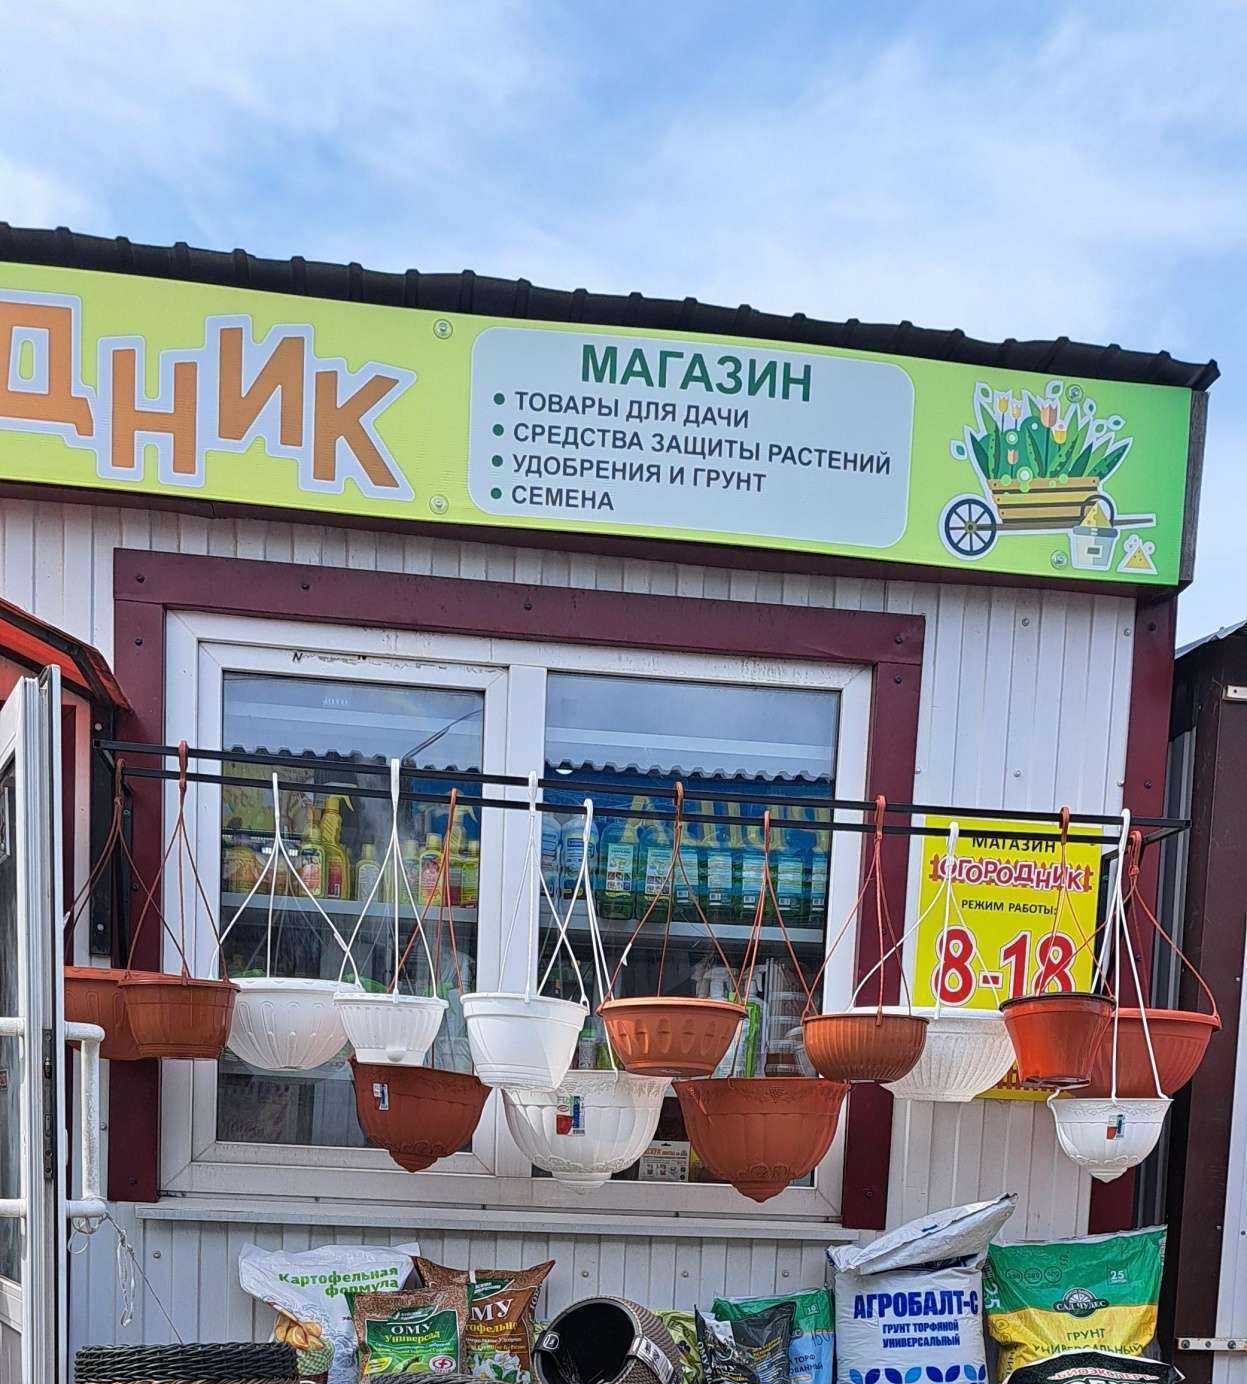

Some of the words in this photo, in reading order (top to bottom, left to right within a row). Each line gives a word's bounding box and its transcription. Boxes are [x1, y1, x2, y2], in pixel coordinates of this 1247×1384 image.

[581, 343, 812, 401] МАГАЗИН
[514, 391, 619, 417] ТОВАРЫ
[626, 399, 676, 422] ДЛЯ
[683, 404, 749, 428] ДАЧИ
[513, 422, 643, 452] СРЕДСТВА
[651, 432, 760, 461] ЗАЩИТЫ
[768, 443, 891, 475] РАСТЕНИЙ
[512, 453, 661, 483] УДОБРЕНИЯ
[670, 465, 685, 484] И
[693, 467, 767, 492] ГРУНТ
[512, 485, 614, 511] СЕМЕНА
[938, 856, 1084, 891] ОГОРОДНИК
[961, 899, 1004, 911] РЕЖИМ
[278, 1267, 399, 1287] Картофельная
[1110, 1270, 1124, 1281] 25
[471, 1298, 514, 1321] МУ
[853, 1290, 979, 1319] АГРОБАЛТ-С
[391, 1322, 432, 1334] ОМУ
[882, 1323, 910, 1334] ГРУНТ
[913, 1321, 959, 1333] ТОРФЯНОЙ
[1067, 1328, 1105, 1341] ГРУНТ
[882, 1334, 960, 1348] УНИВЕРСАЛЬНЫЙ
